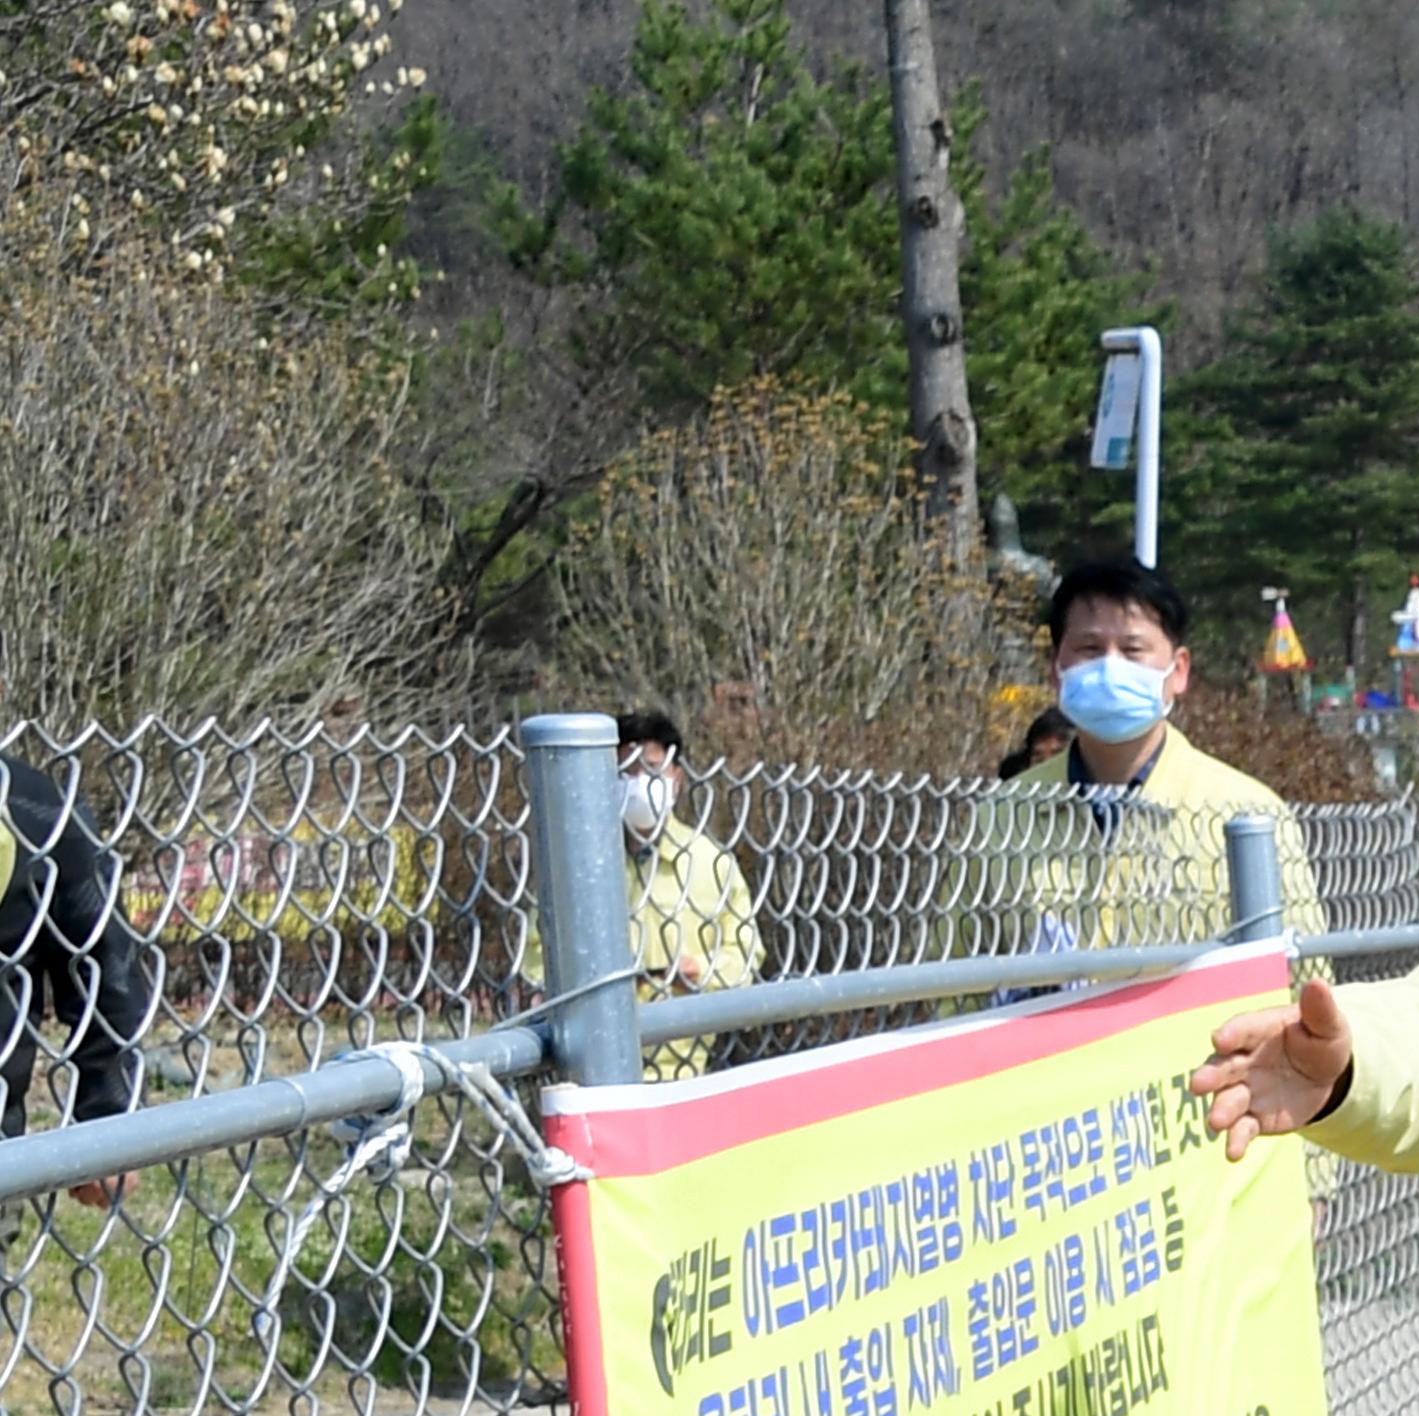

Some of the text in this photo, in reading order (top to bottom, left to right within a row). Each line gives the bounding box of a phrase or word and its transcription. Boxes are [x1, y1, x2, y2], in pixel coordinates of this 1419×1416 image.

[742, 1158, 963, 1338] 아프리카돼지열병
[968, 1140, 1017, 1246] 차단
[1019, 1107, 1108, 1223] 목적으로
[1110, 1079, 1172, 1185] 설치한
[967, 1257, 1040, 1382] 출입문
[1045, 1233, 1087, 1338] 이용
[1093, 1219, 1116, 1309] 시
[1114, 1199, 1161, 1299] 잠금
[1161, 1185, 1185, 1273] 등
